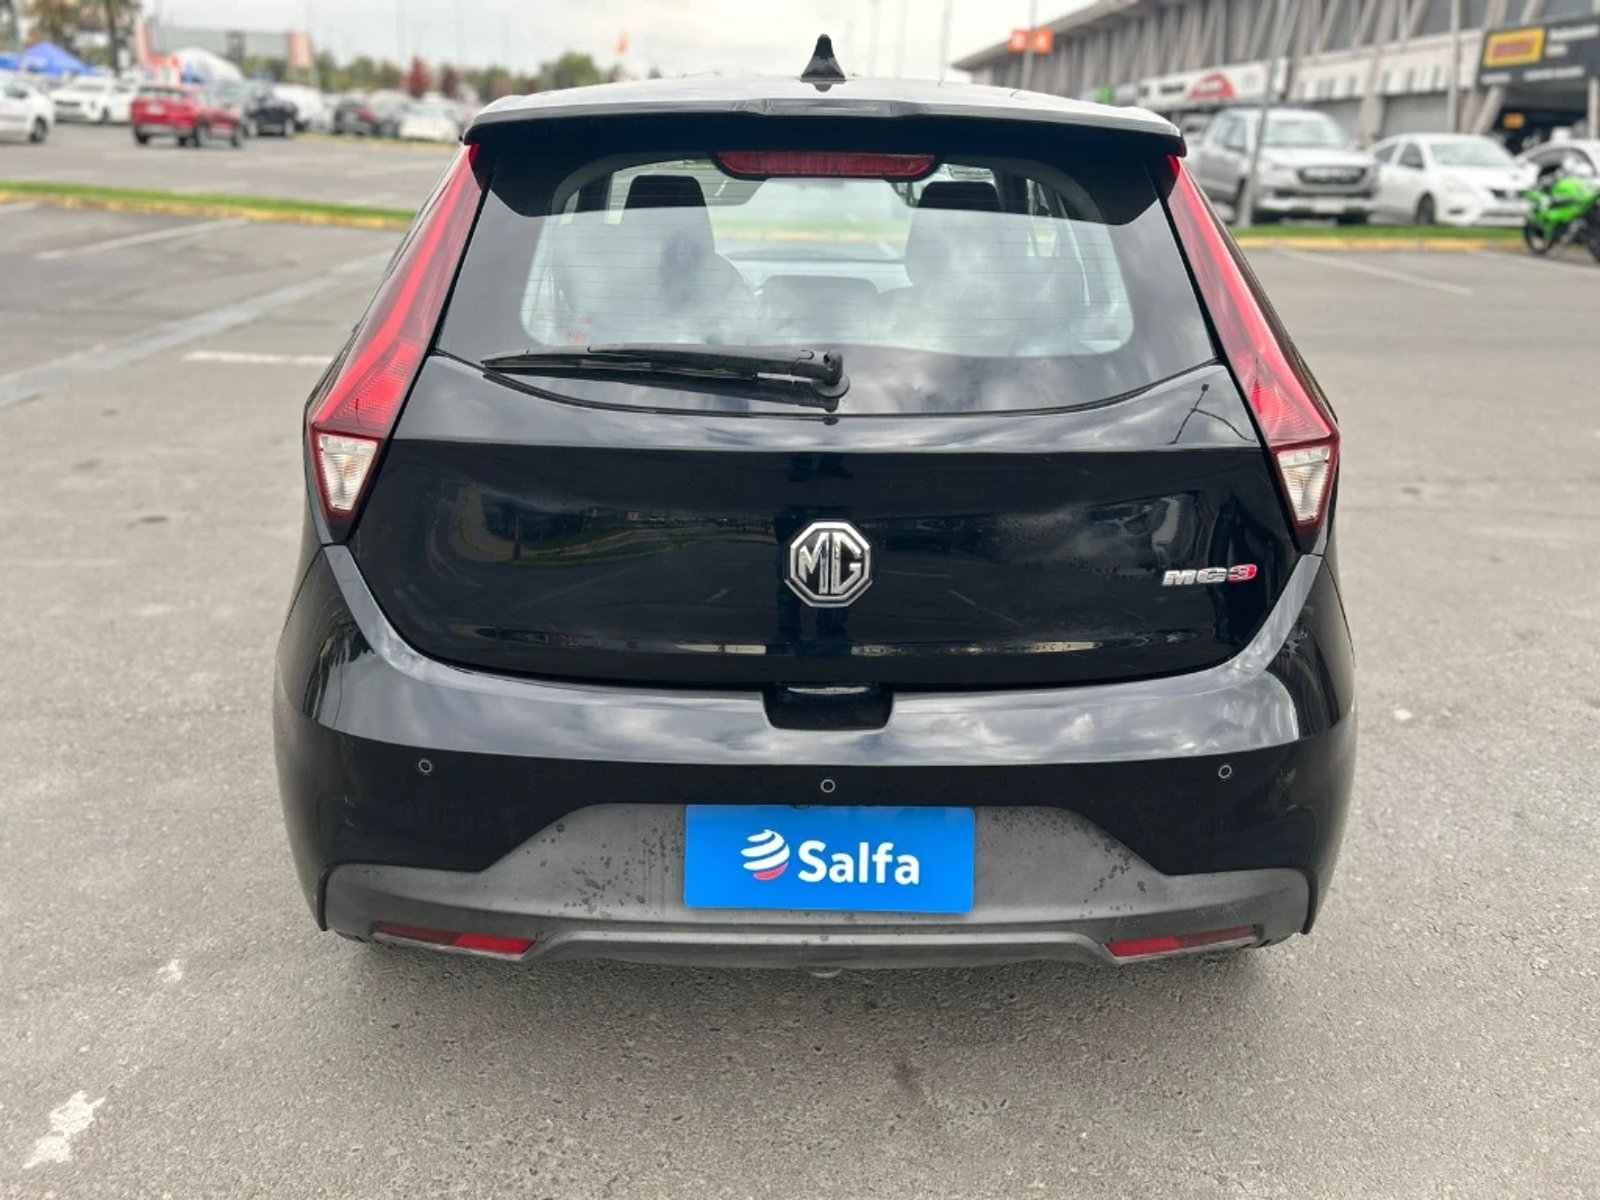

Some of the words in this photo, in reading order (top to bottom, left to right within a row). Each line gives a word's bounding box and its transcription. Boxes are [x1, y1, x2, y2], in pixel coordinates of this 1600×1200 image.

[798, 532, 862, 594] MG
[1162, 564, 1258, 586] MG3
[798, 840, 920, 885] Salfa
